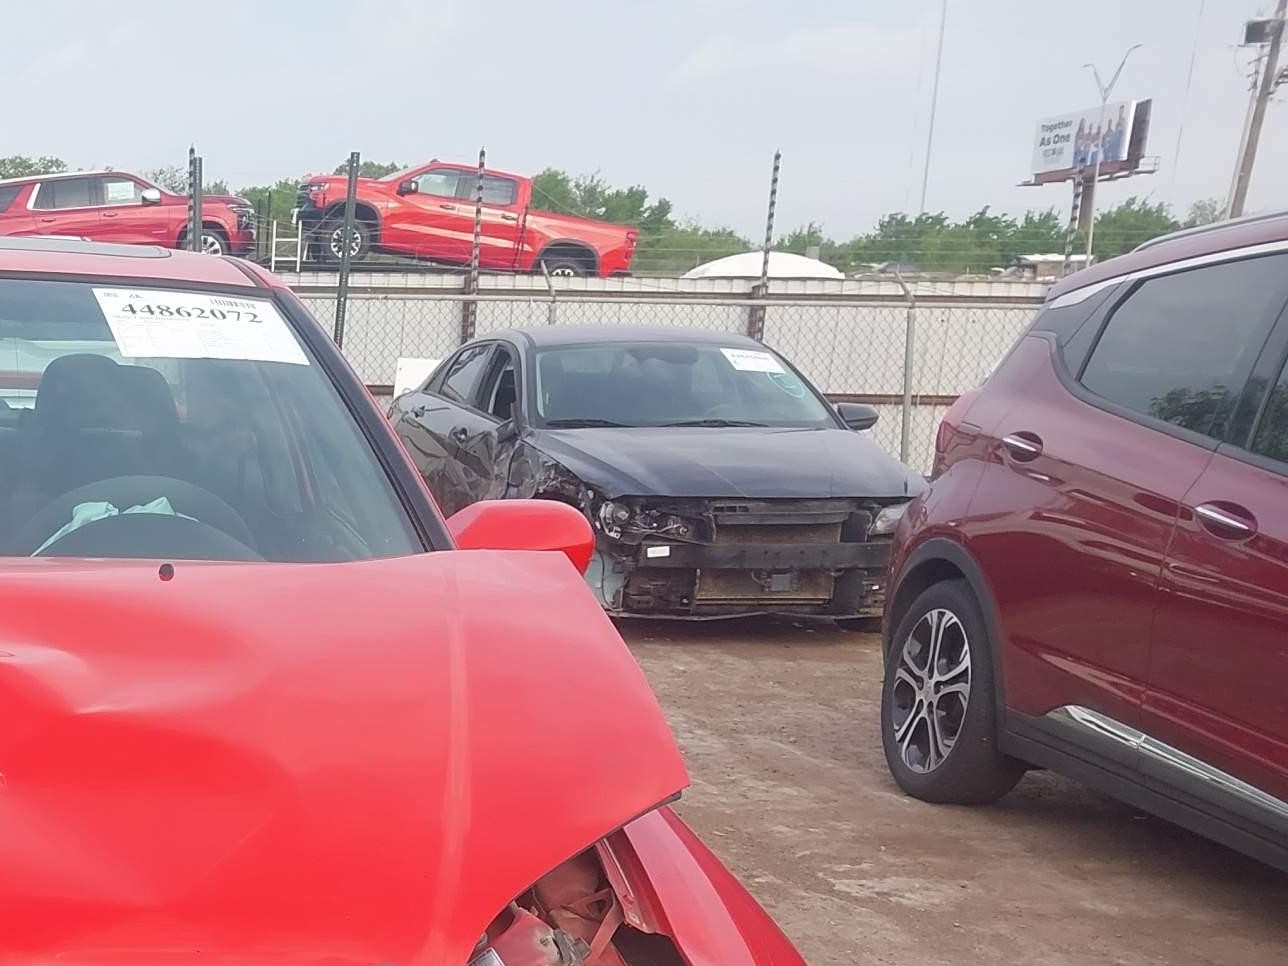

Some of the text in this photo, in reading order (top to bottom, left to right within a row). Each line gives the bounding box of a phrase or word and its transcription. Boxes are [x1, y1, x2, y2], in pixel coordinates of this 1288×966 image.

[1041, 120, 1073, 133] Together
[1040, 133, 1071, 147] As One
[121, 303, 263, 323] 44862072
